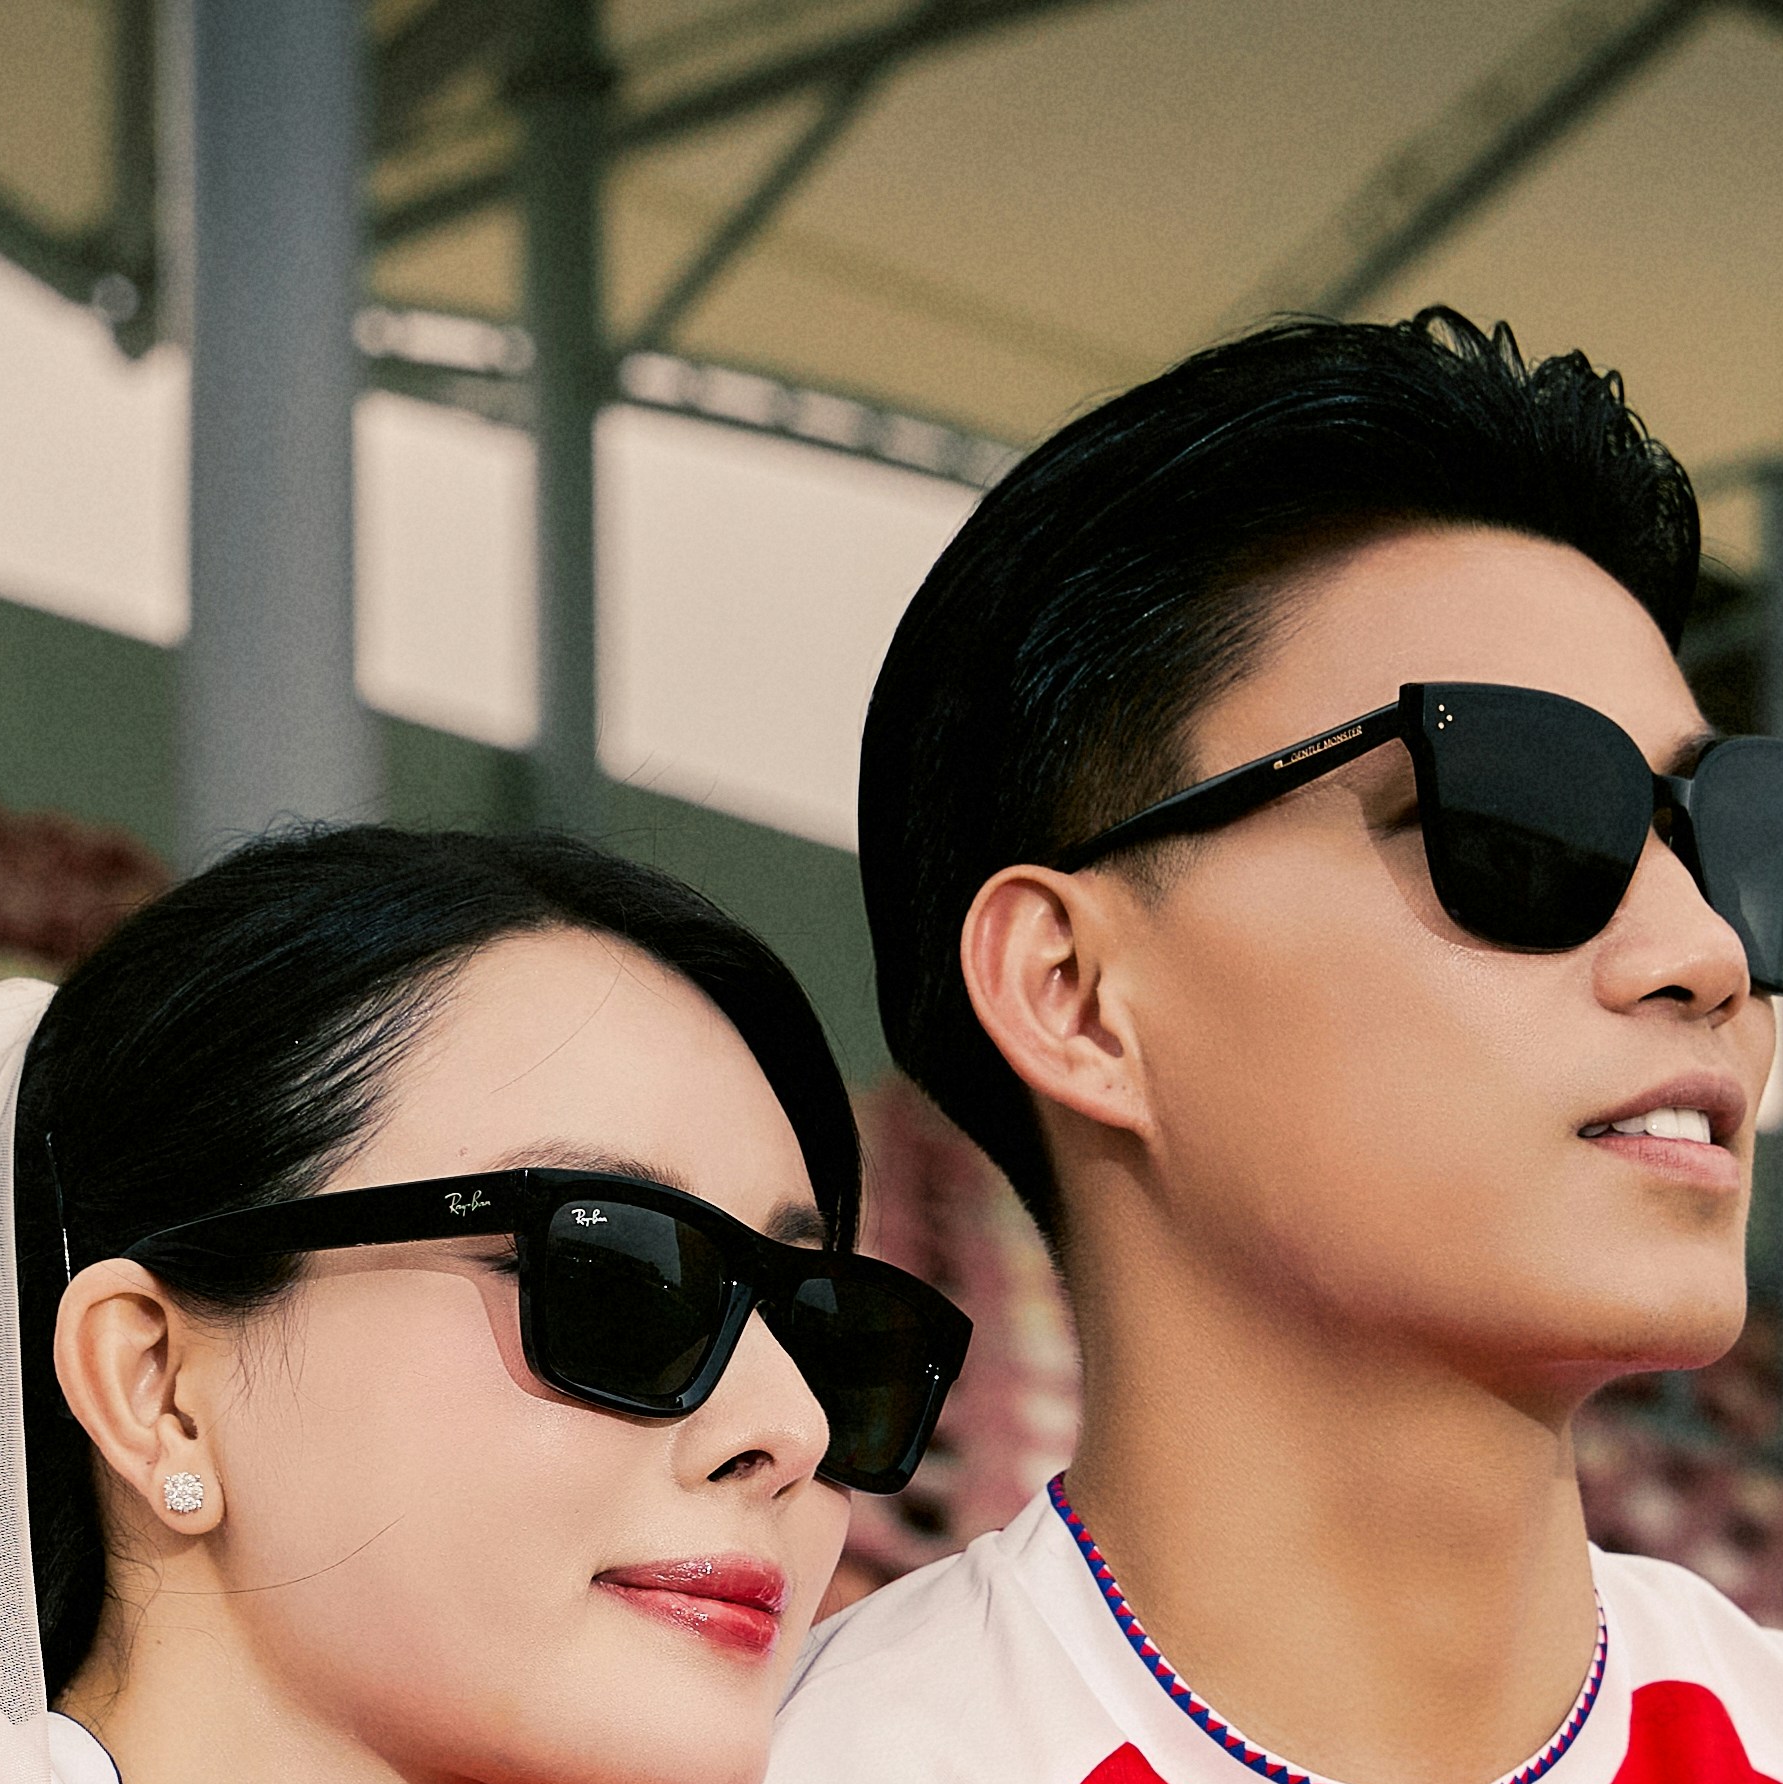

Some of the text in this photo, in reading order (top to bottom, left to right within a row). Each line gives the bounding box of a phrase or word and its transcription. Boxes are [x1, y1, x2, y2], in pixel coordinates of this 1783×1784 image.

[1290, 724, 1363, 763] GENTLE MONSTER
[444, 1189, 491, 1217] Ray-Ban
[571, 1208, 608, 1227] Ray-Ban
